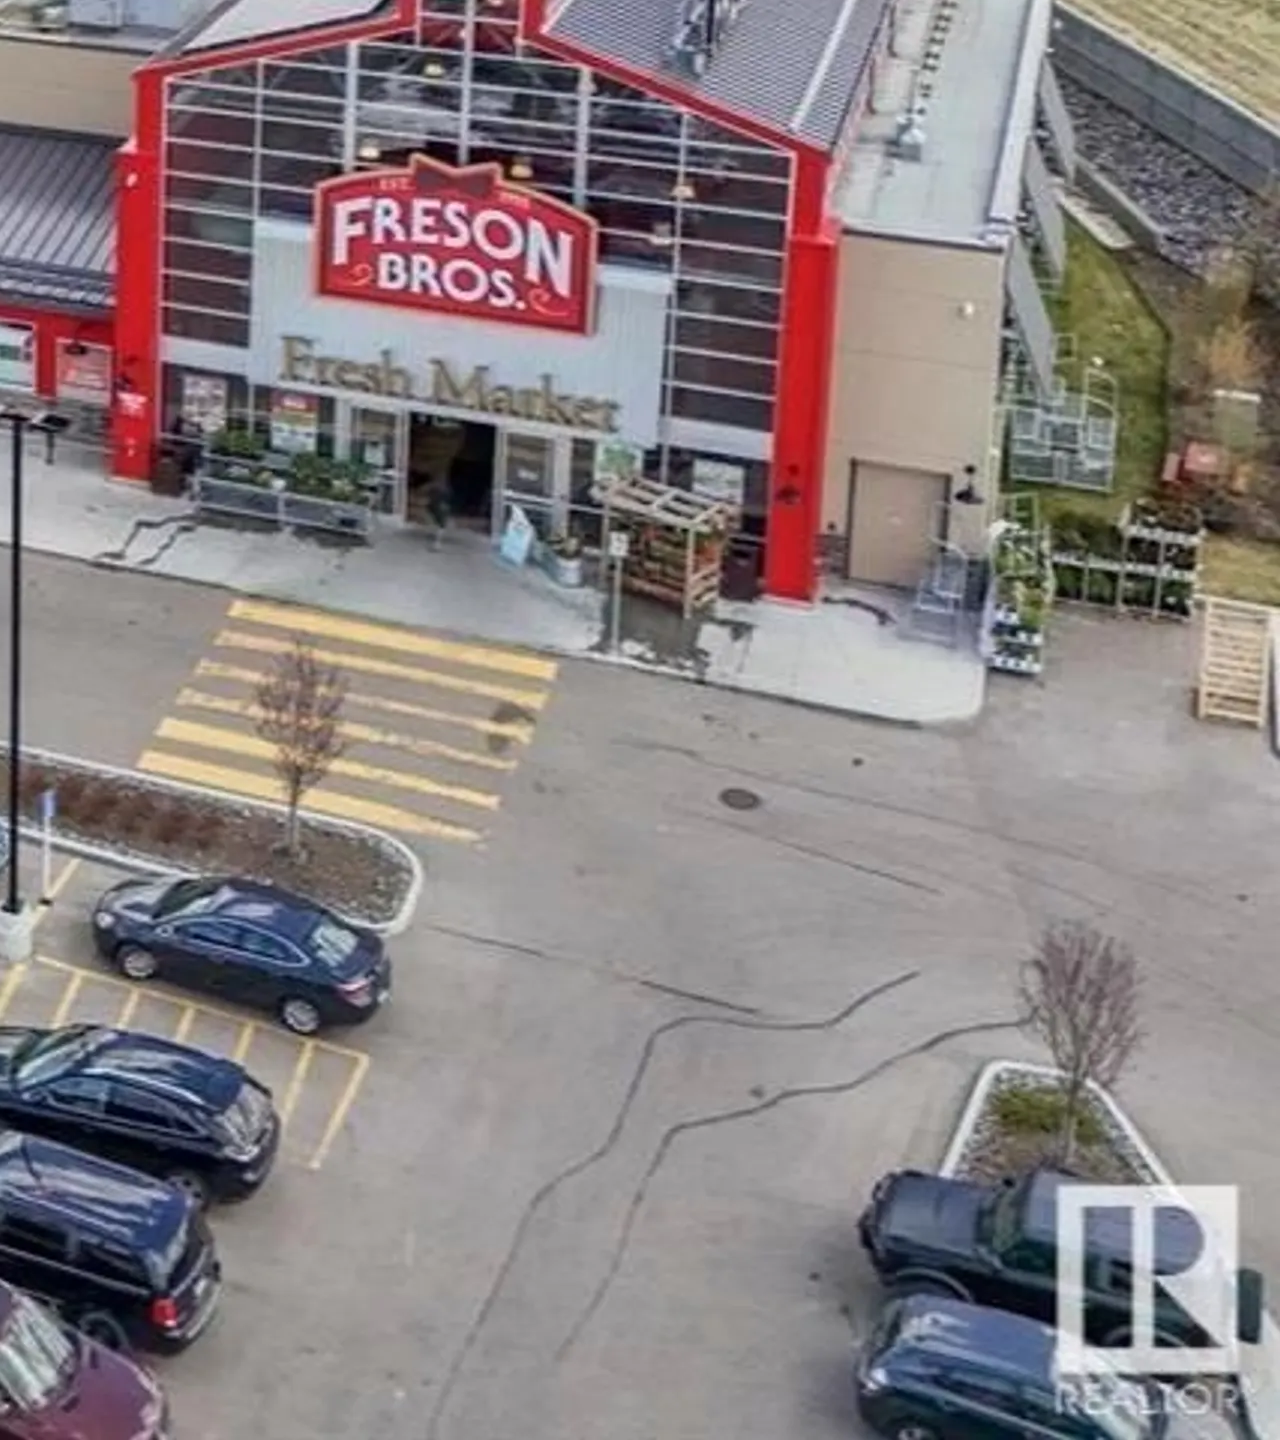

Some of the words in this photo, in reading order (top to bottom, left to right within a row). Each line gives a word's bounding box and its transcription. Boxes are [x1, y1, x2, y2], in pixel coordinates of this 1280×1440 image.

[332, 197, 574, 298] FRESON
[376, 252, 527, 311] BROS.
[279, 336, 414, 398] Fresh
[430, 358, 622, 433] Market
